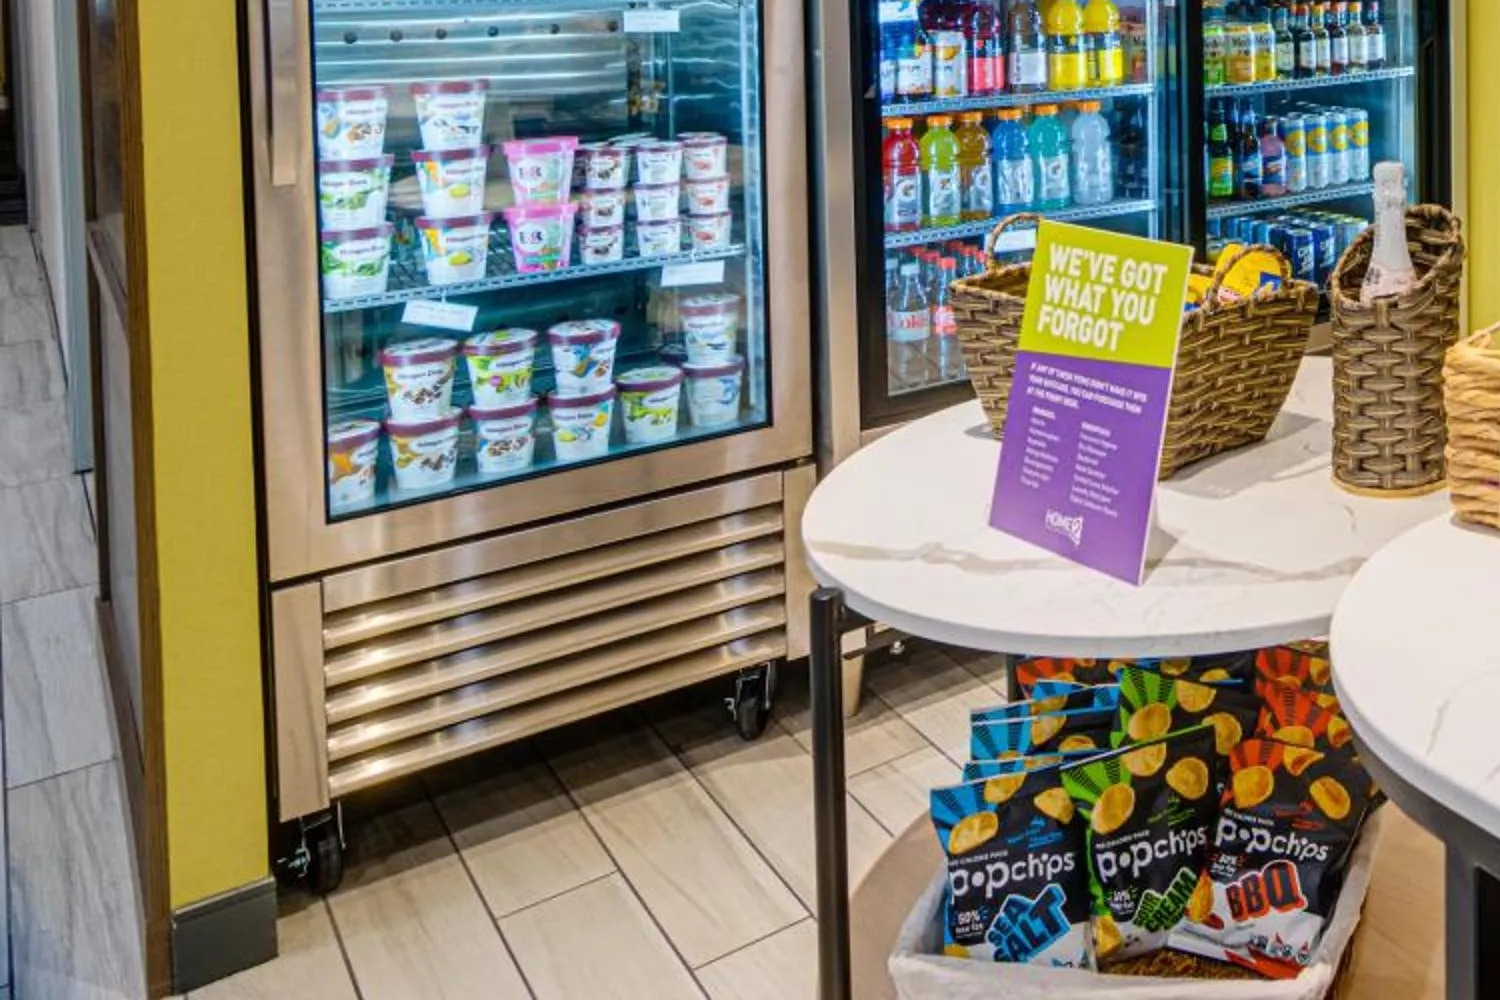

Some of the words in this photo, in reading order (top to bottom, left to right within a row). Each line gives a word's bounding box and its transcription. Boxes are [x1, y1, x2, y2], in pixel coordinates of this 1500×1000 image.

[1050, 243, 1117, 283] WE'VE
[1119, 258, 1168, 291] GOT
[1044, 275, 1108, 315] WHAT
[1111, 288, 1157, 325] YOU
[1036, 306, 1125, 351] FORGOT
[1096, 825, 1207, 883] popchips
[1214, 815, 1330, 861] popchips
[949, 852, 1076, 905] popchips
[1226, 861, 1306, 922] BBQ
